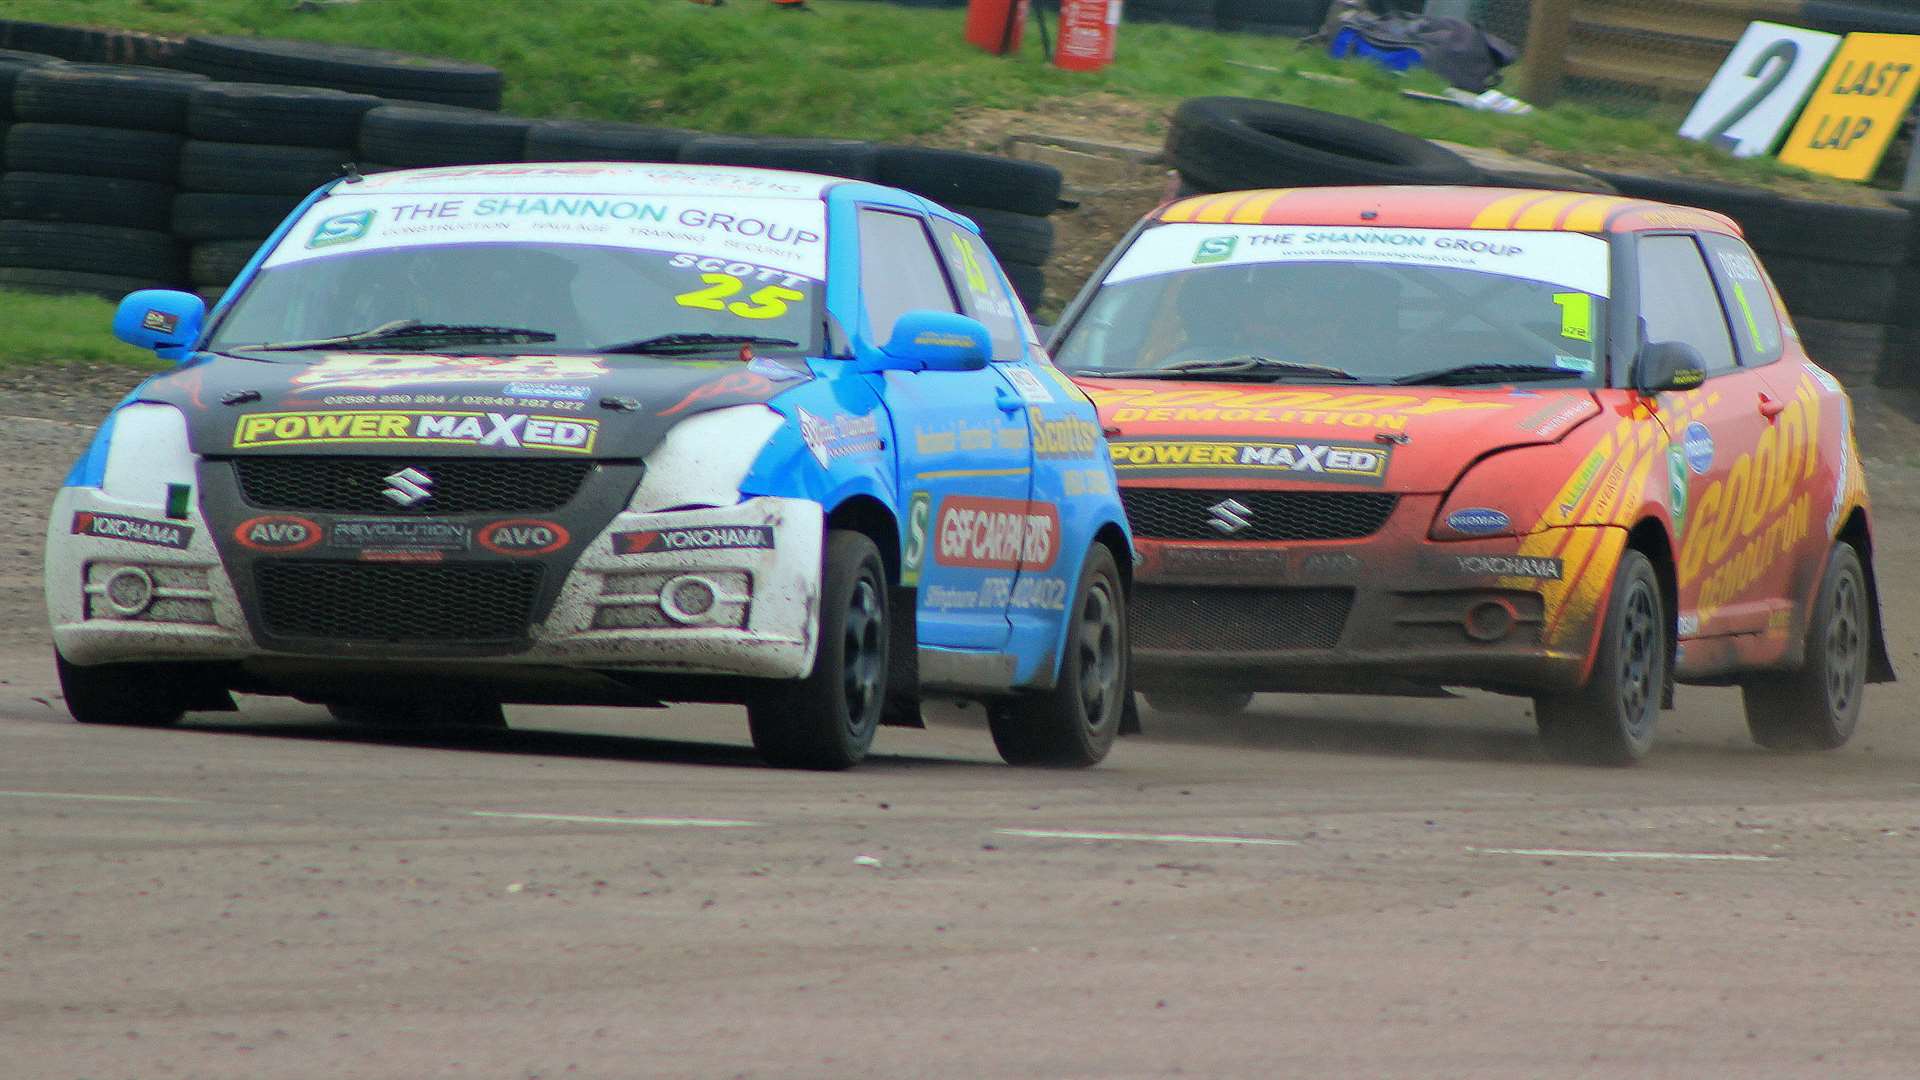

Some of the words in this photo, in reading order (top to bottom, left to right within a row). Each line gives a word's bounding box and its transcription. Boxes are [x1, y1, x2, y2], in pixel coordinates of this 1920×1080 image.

[1832, 61, 1913, 97] LAST
[1702, 38, 1799, 150] 2
[1808, 114, 1873, 150] LAP
[381, 223, 511, 237] CONSTRUCTION
[629, 226, 707, 242] TRAINING
[392, 201, 465, 222] THE
[473, 199, 668, 222] SHANNON
[678, 209, 820, 246] GROUP
[1248, 233, 1296, 247] THE
[1303, 232, 1427, 246] SHANNON
[1434, 236, 1523, 258] GROUP
[668, 254, 810, 288] SCOTT
[674, 273, 805, 320] 25
[1552, 292, 1592, 342] 1
[243, 415, 411, 441] POWER
[1111, 407, 1408, 430] DEMOLITION
[1109, 445, 1238, 464] POWER
[92, 516, 179, 545] YOKOHAMA
[250, 524, 306, 542] AVO
[334, 522, 464, 538] REVOLUTION
[494, 527, 552, 545] AVO
[660, 529, 767, 549] YOKOHAMA
[1456, 556, 1560, 578] YOKOHAMA
